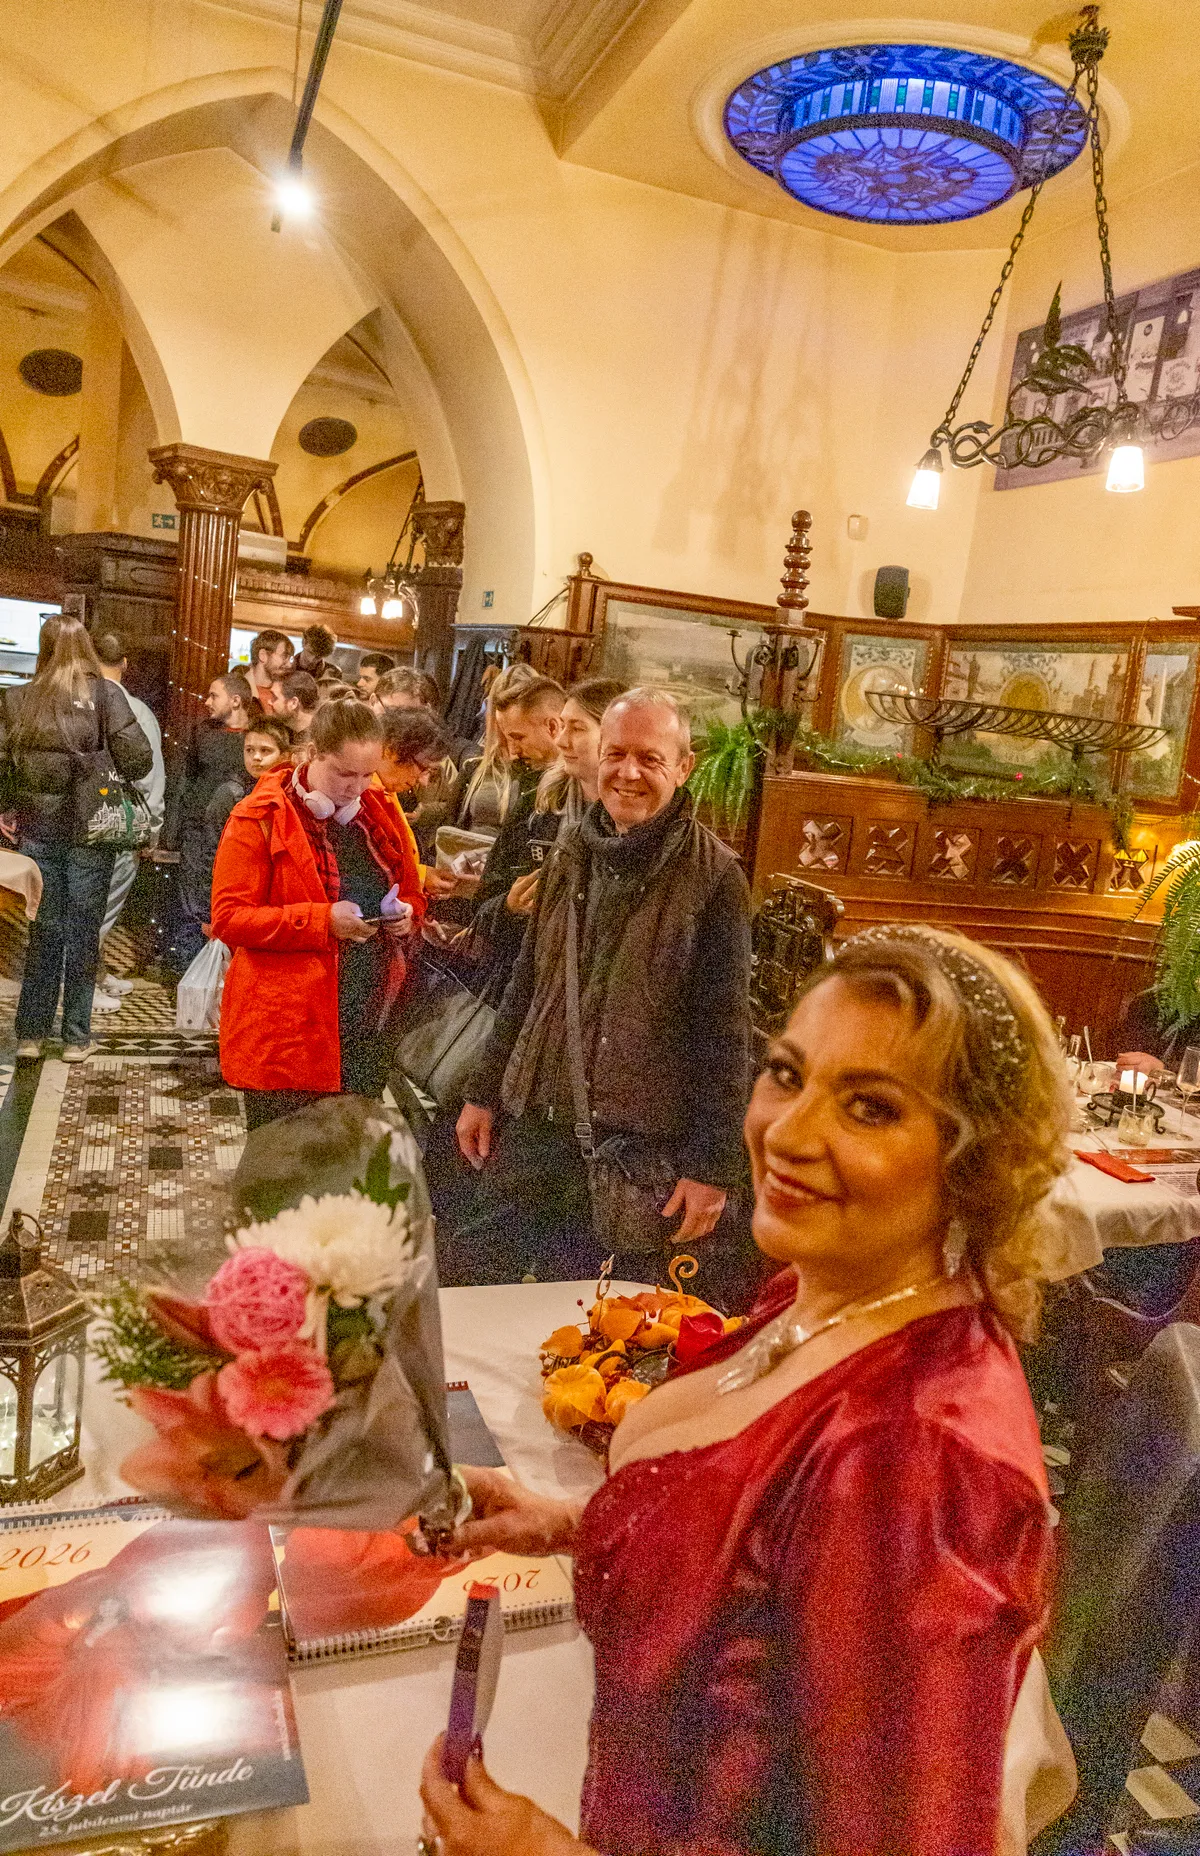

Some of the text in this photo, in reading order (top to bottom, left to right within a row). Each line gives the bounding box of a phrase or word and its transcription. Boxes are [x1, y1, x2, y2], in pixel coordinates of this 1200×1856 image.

[0, 1540, 93, 1571] 2026
[0, 1758, 253, 1828] Kiszel Tünde
[142, 1803, 193, 1821] naptár
